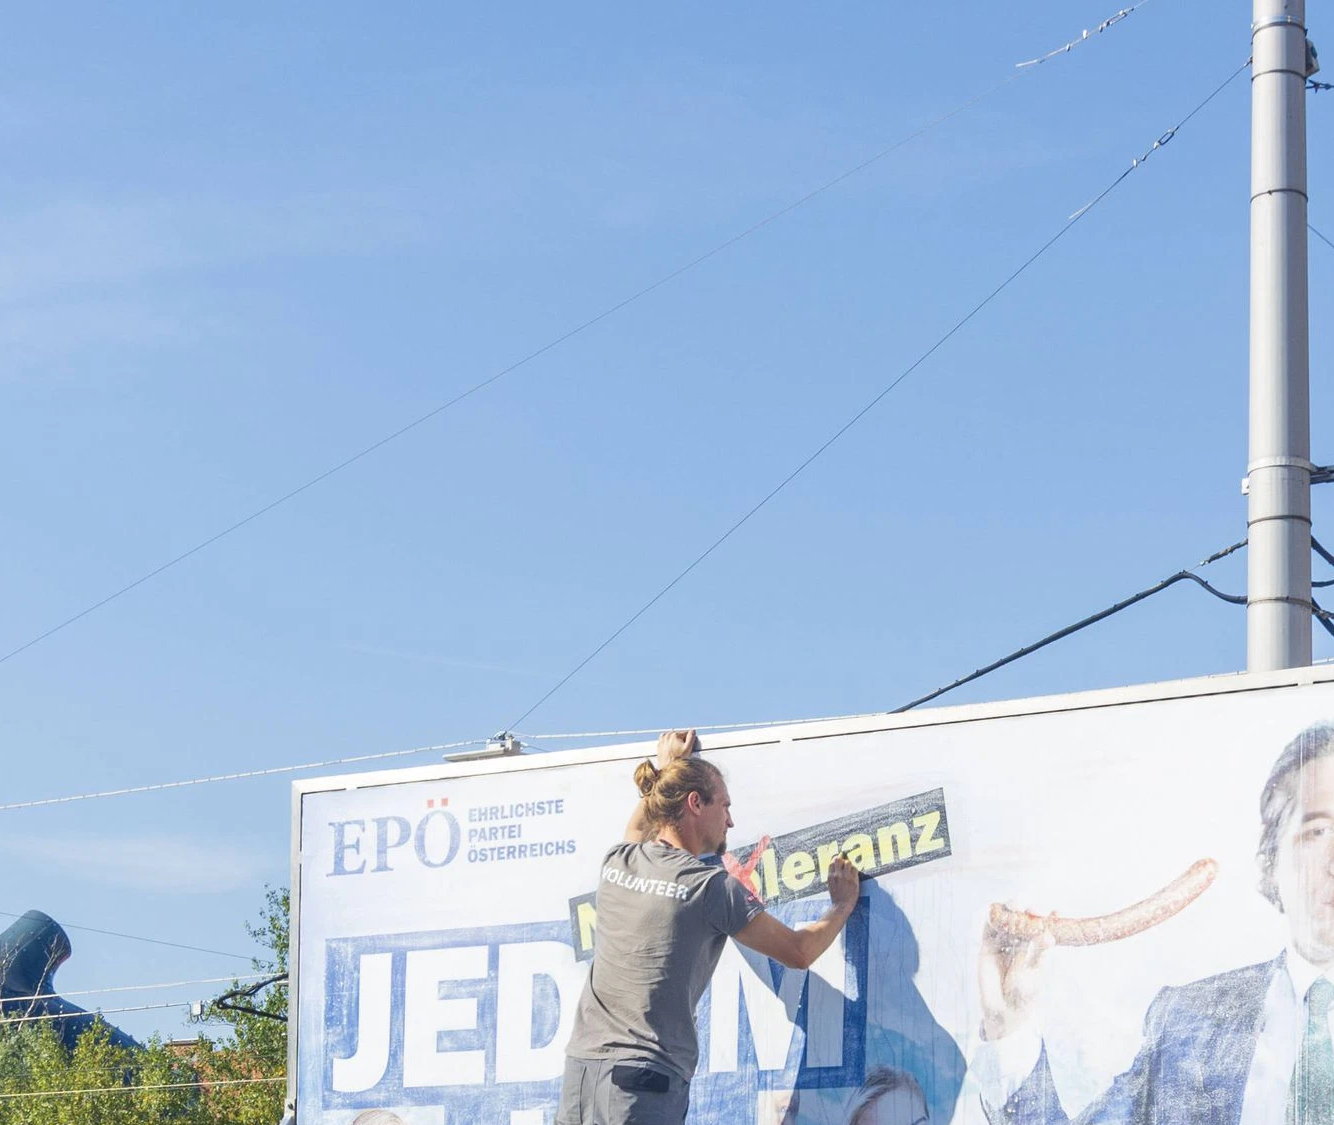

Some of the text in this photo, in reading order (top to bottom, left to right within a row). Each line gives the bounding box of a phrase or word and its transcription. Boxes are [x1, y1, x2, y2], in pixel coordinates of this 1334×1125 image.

[468, 799, 564, 822] EHRLICHSTE
[326, 797, 461, 877] EPÖ
[468, 824, 522, 842] PARTEI
[468, 839, 577, 863] ÖSTERREICHS
[749, 810, 945, 900] leranz
[602, 865, 689, 900] VOLUNTEER
[332, 922, 847, 1092] JEDM
